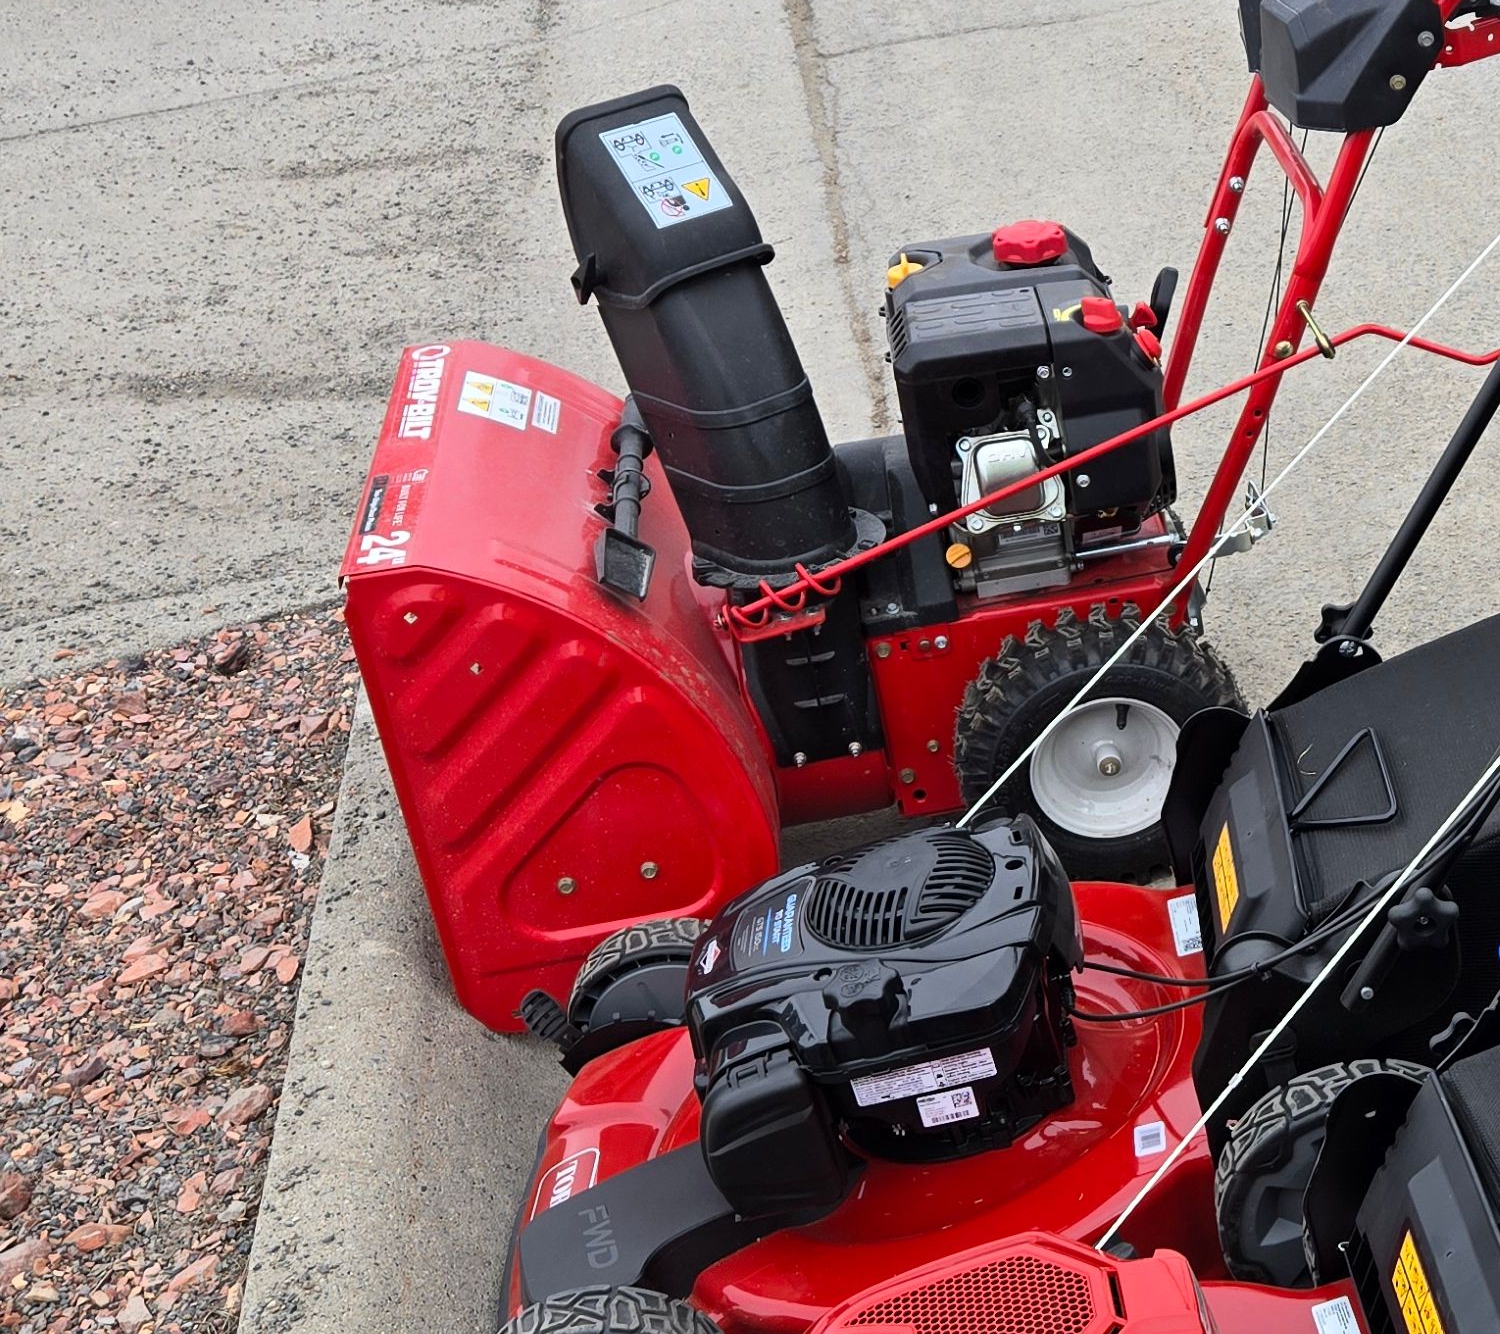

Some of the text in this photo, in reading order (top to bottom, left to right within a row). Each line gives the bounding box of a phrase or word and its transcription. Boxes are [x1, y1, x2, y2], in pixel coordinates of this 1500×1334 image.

[400, 357, 445, 441] TROY-BILT
[771, 909, 784, 945] TO START
[780, 893, 797, 953] GUARANTEED
[549, 1159, 578, 1208] TOR
[578, 1205, 618, 1269] FWD
